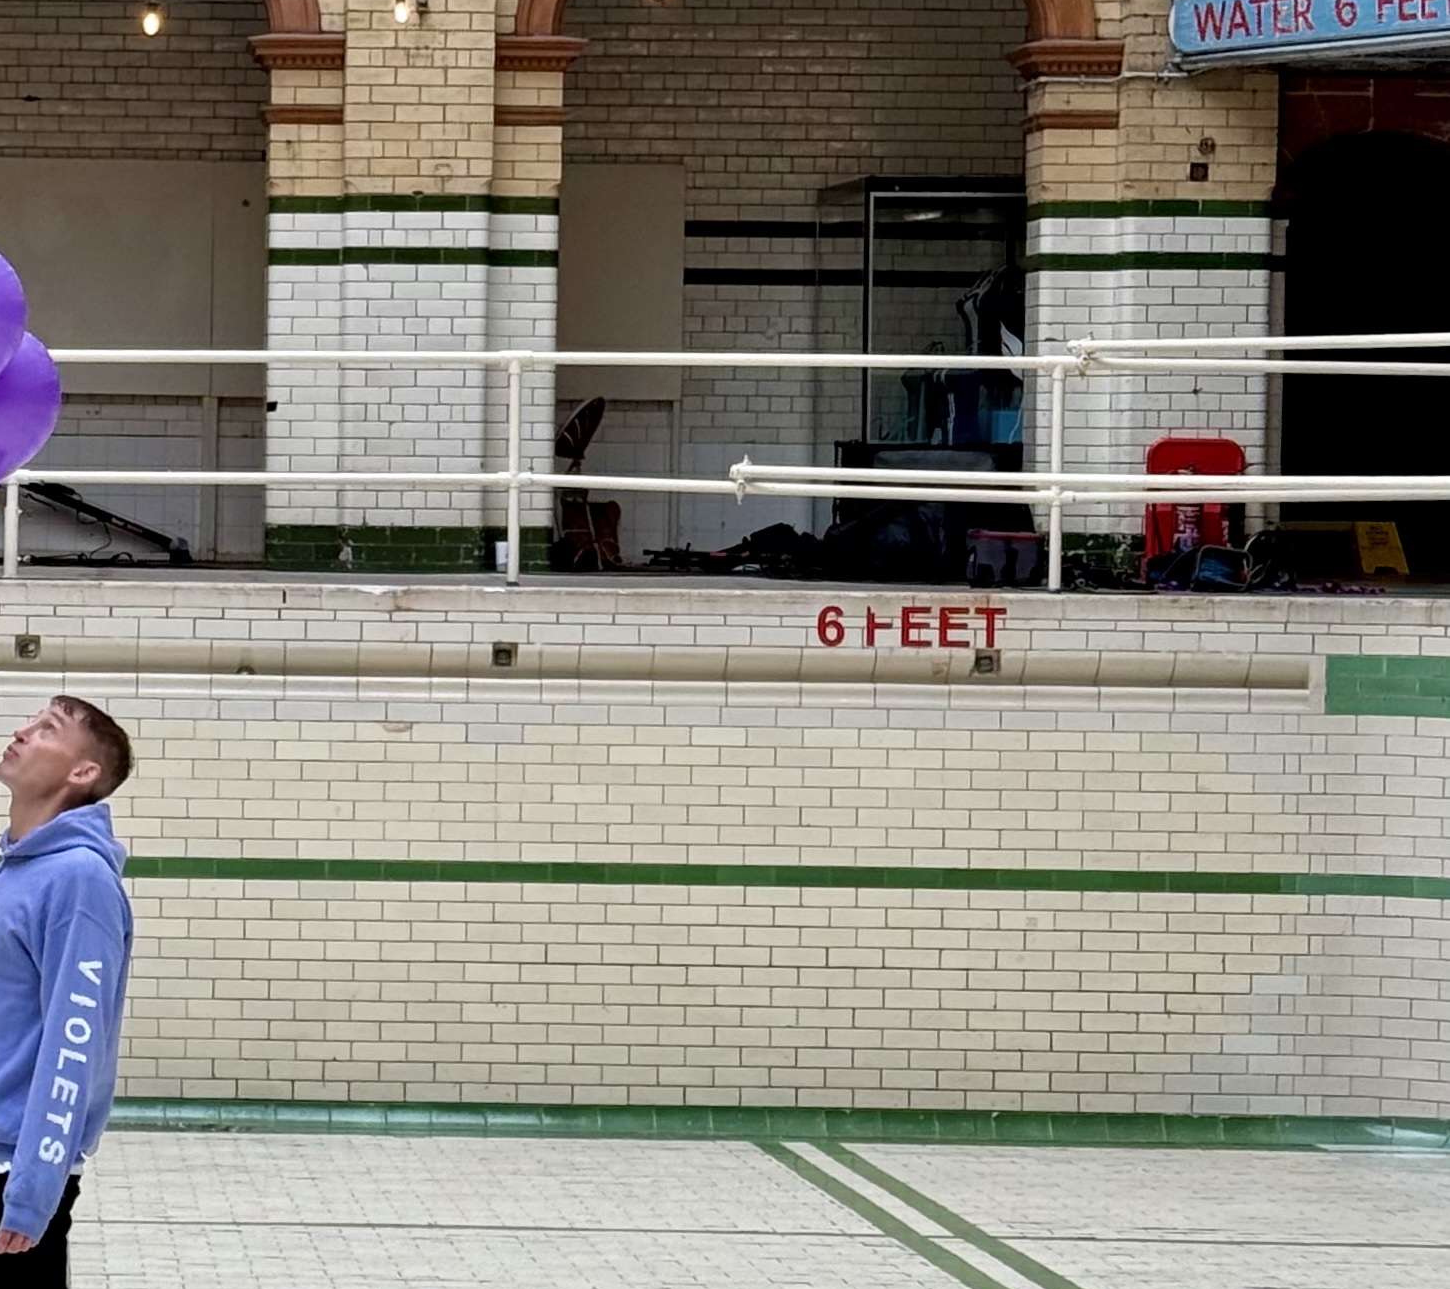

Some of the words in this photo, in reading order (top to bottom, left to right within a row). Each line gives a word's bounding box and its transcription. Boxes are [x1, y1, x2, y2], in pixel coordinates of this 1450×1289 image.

[817, 606, 845, 647] 6
[866, 606, 1007, 648] FEET
[38, 960, 102, 1165] VIOLETS
